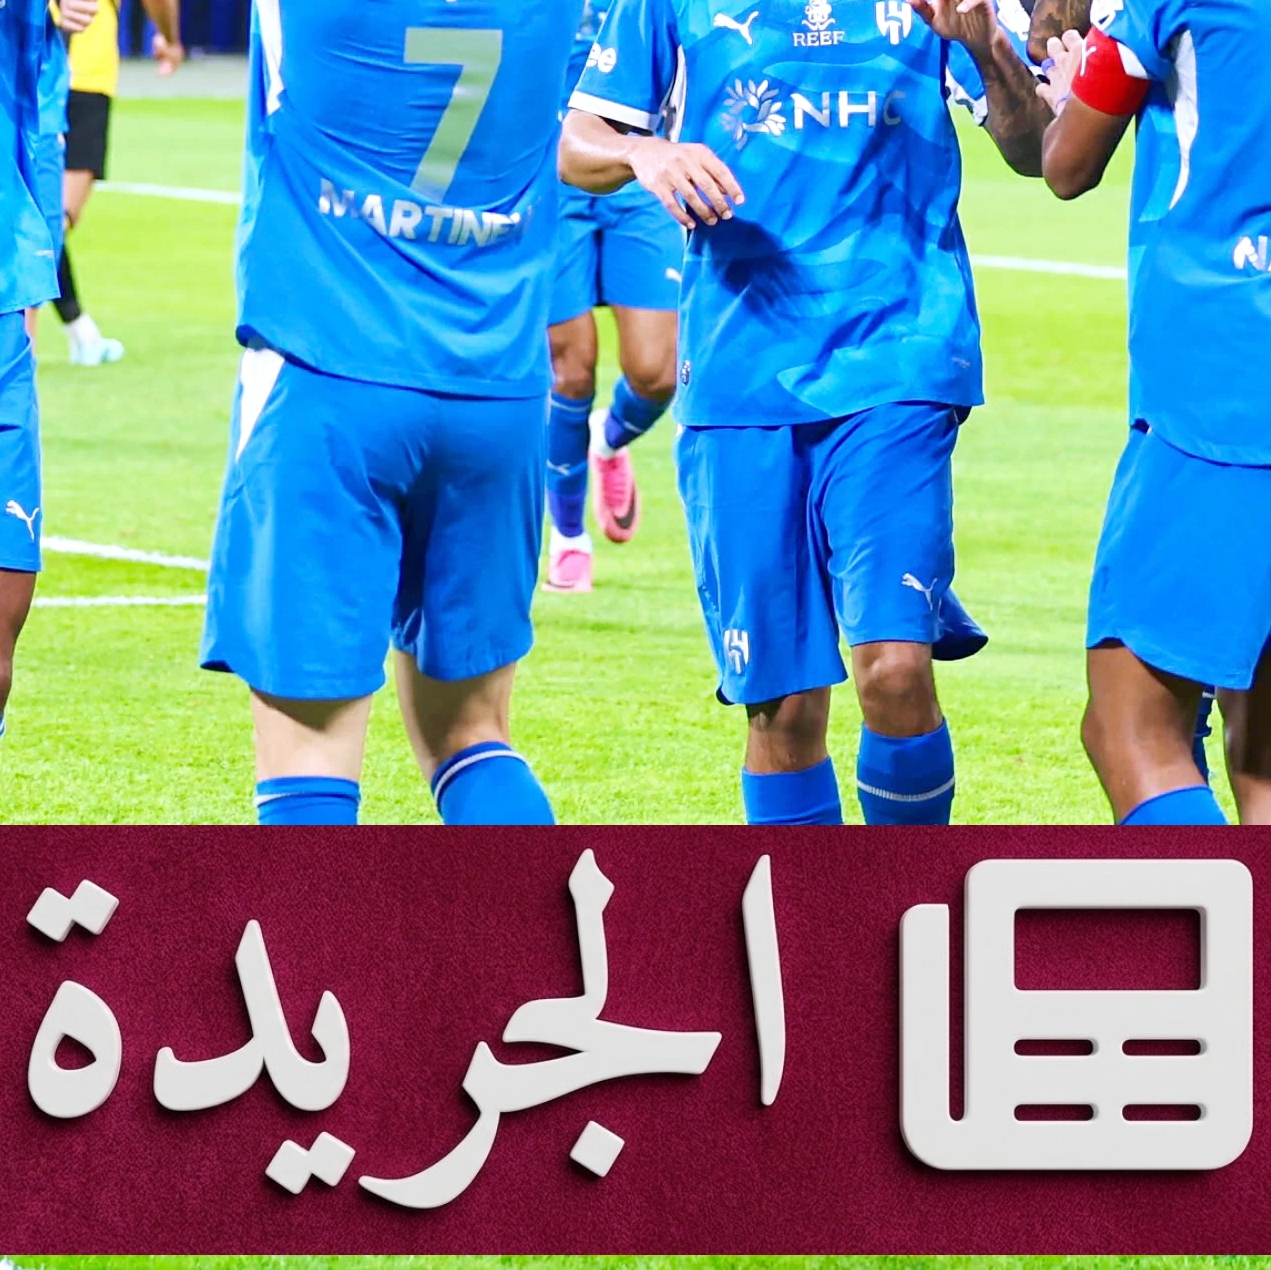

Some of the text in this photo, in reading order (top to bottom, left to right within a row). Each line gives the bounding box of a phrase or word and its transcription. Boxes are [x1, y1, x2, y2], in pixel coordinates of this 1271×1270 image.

[793, 30, 845, 47] REEF
[403, 27, 503, 204] 7
[790, 90, 906, 130] NHC
